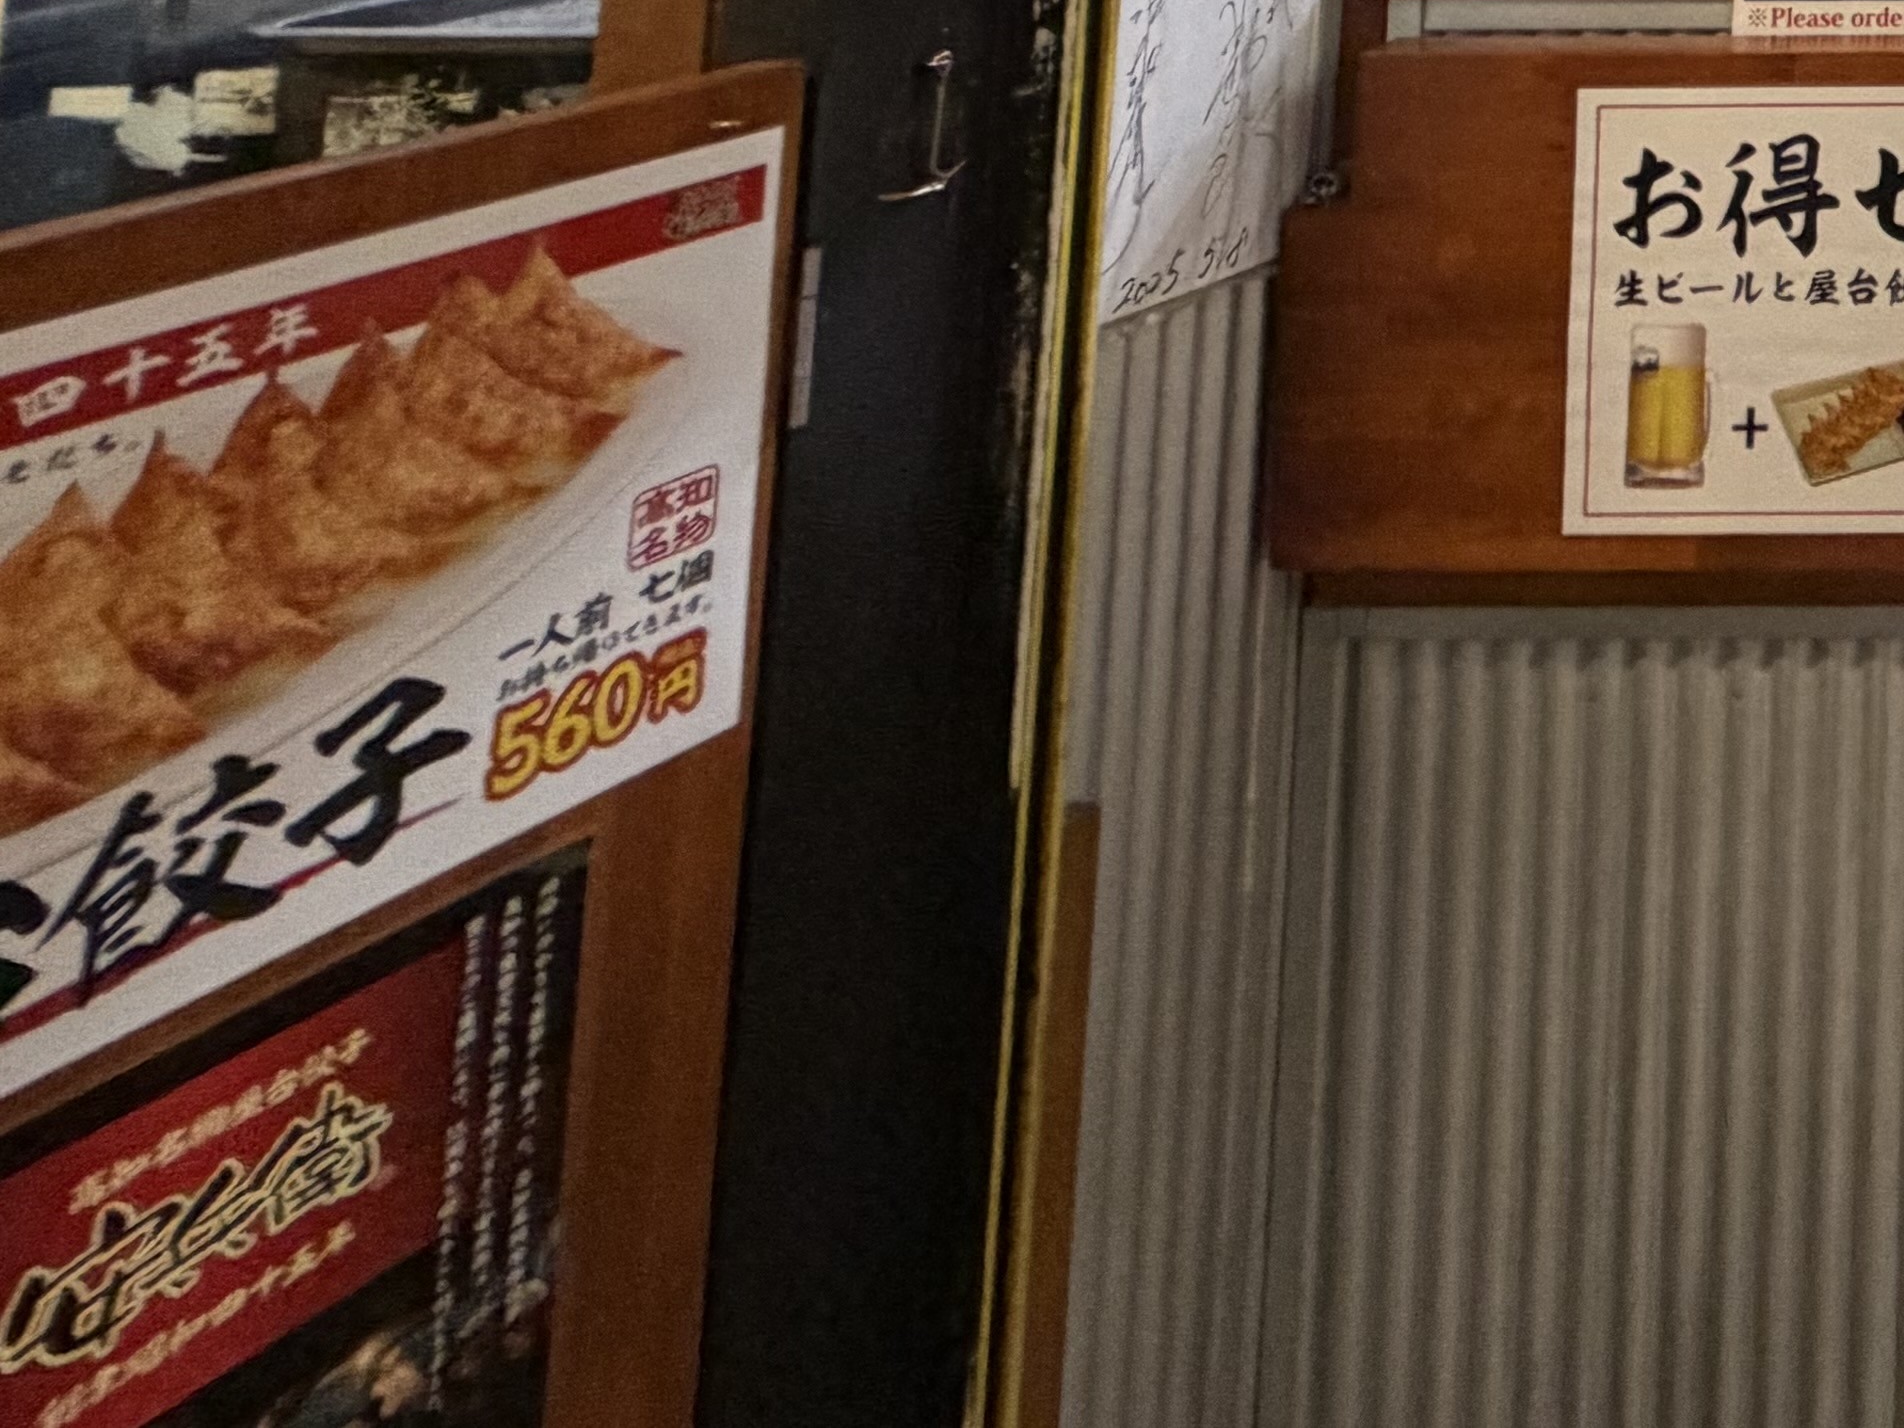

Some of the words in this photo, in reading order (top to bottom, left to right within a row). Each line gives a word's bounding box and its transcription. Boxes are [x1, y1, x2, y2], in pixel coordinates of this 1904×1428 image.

[497, 591, 613, 662] 一人前
[484, 626, 707, 802] 560円
